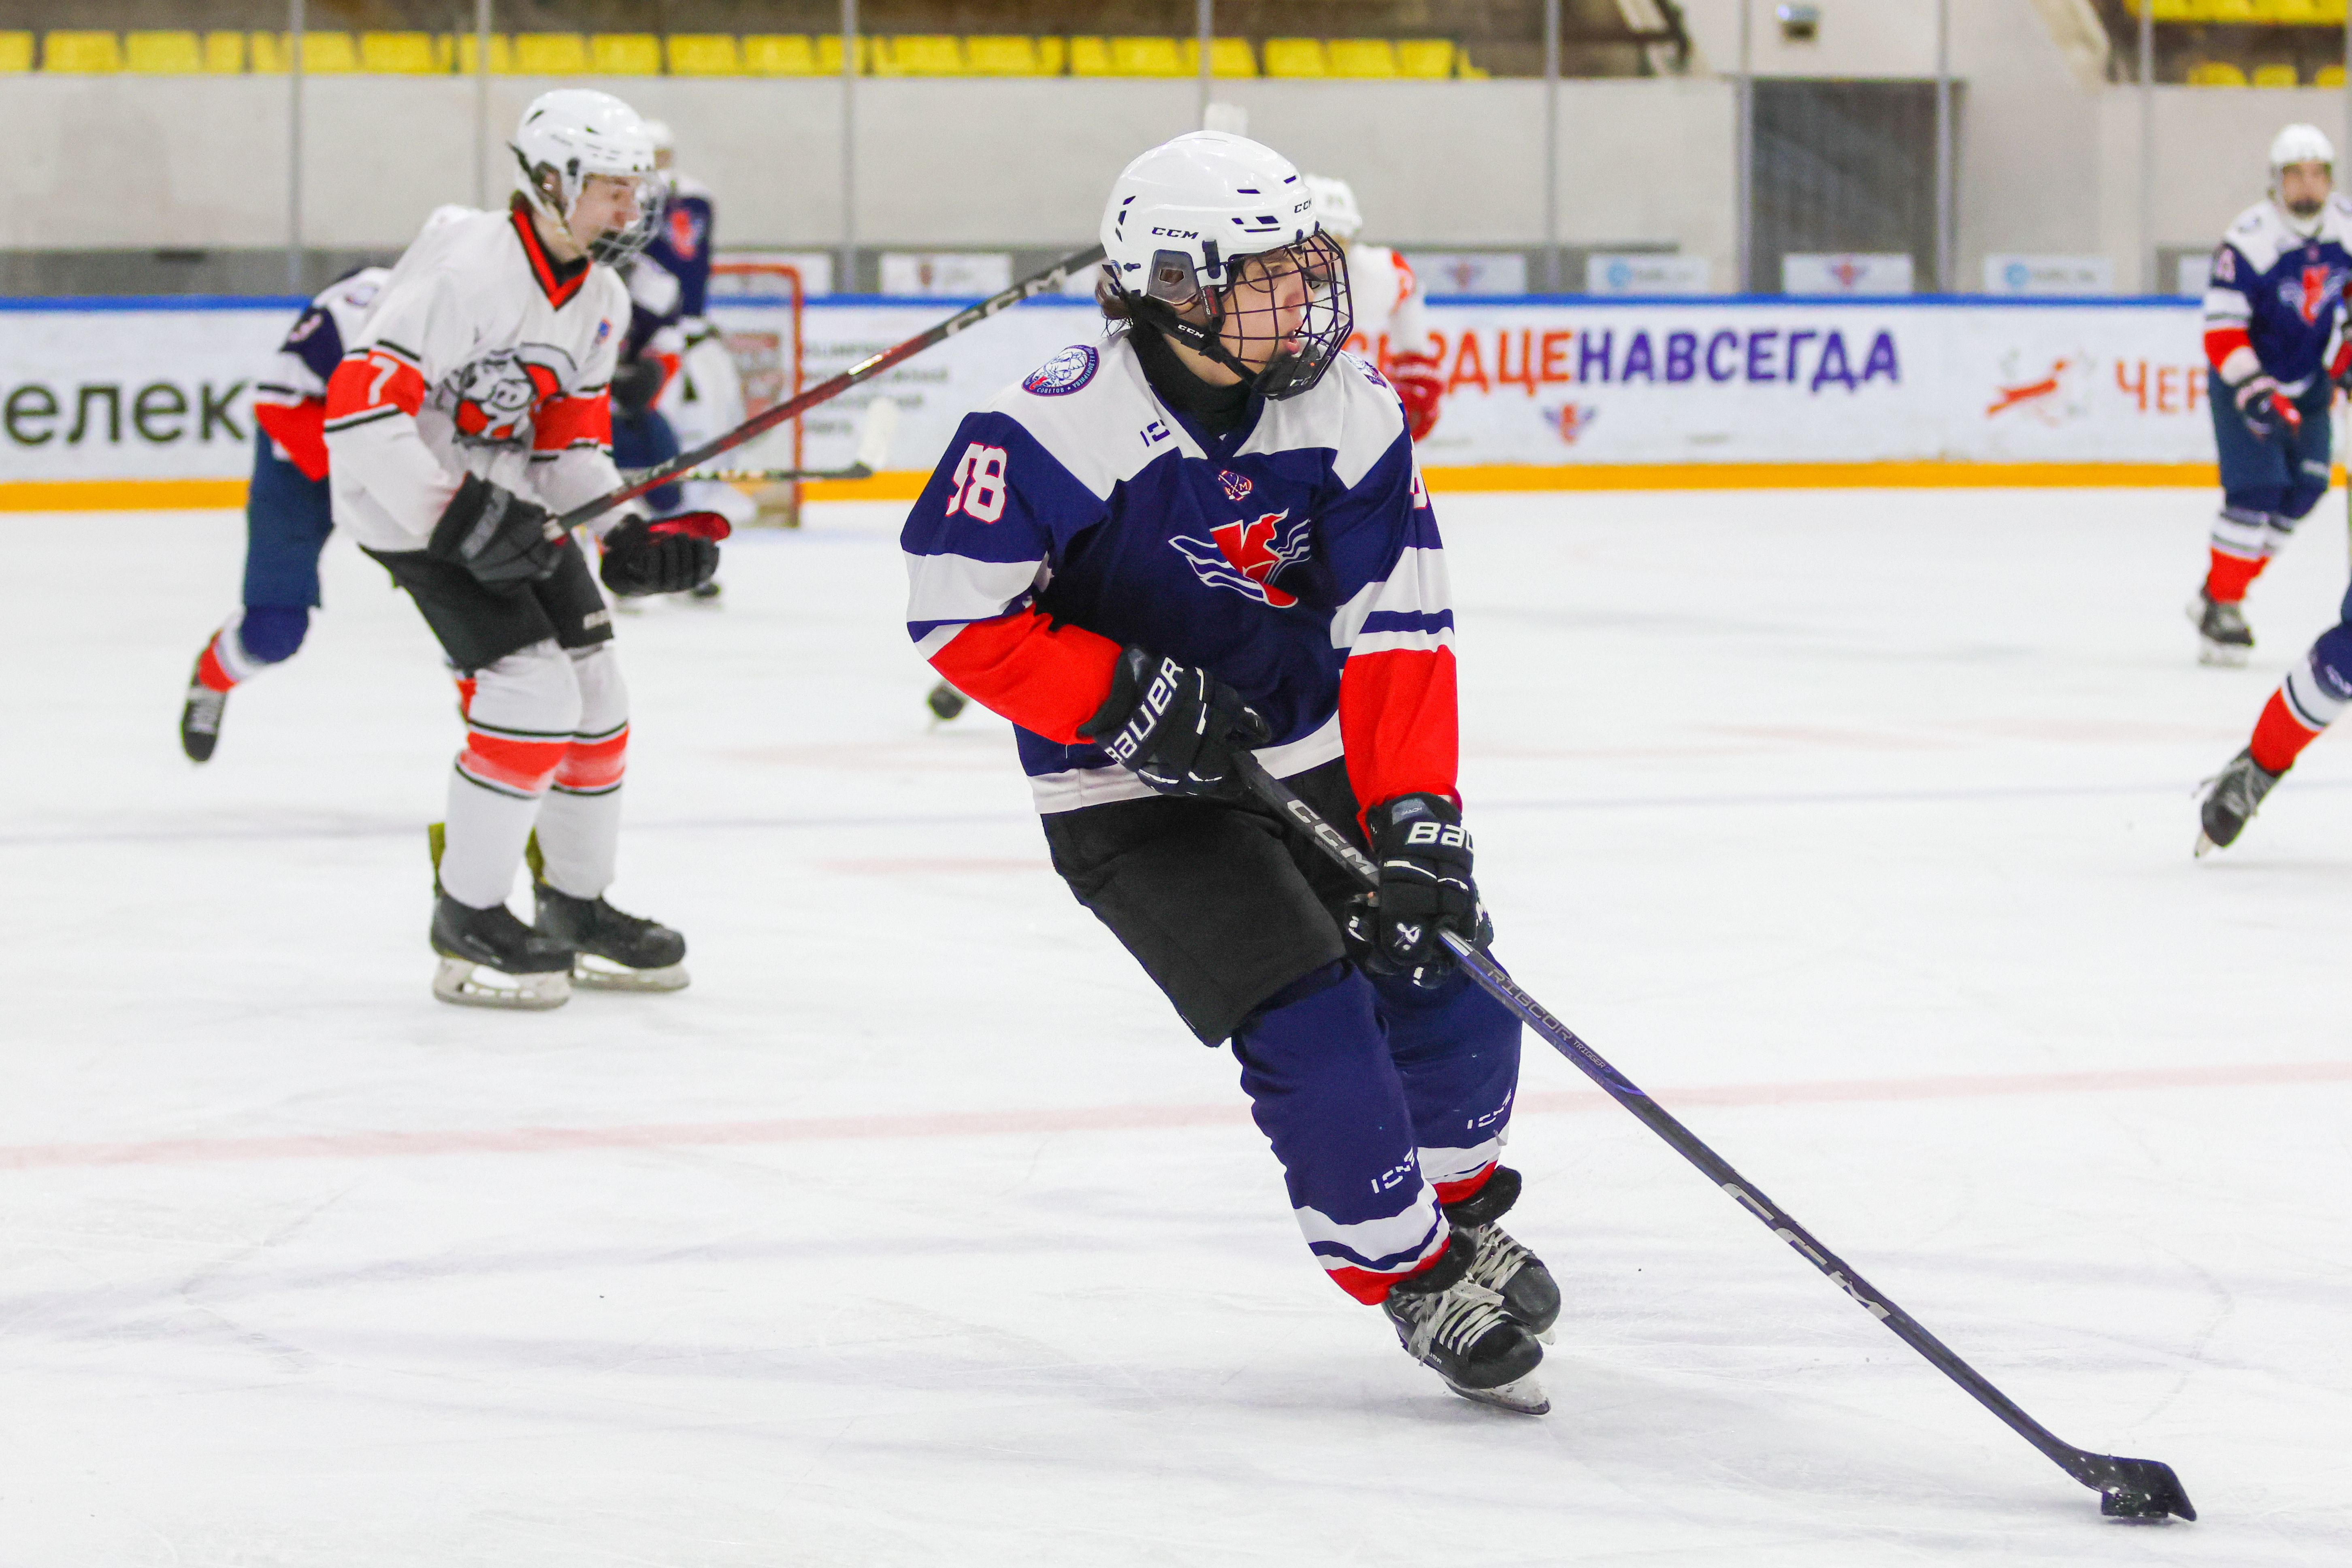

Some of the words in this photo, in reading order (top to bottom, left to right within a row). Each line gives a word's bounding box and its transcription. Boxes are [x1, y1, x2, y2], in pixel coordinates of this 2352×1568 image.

[1294, 198, 1312, 213] CCM
[1152, 227, 1199, 239] CCM
[1178, 324, 1204, 338] CCM
[368, 356, 399, 405] 7
[945, 441, 1008, 524] 98
[1287, 799, 1378, 875] CCM
[1487, 969, 1572, 1040] RIBCOR
[1574, 1039, 1606, 1068] TRIGGER
